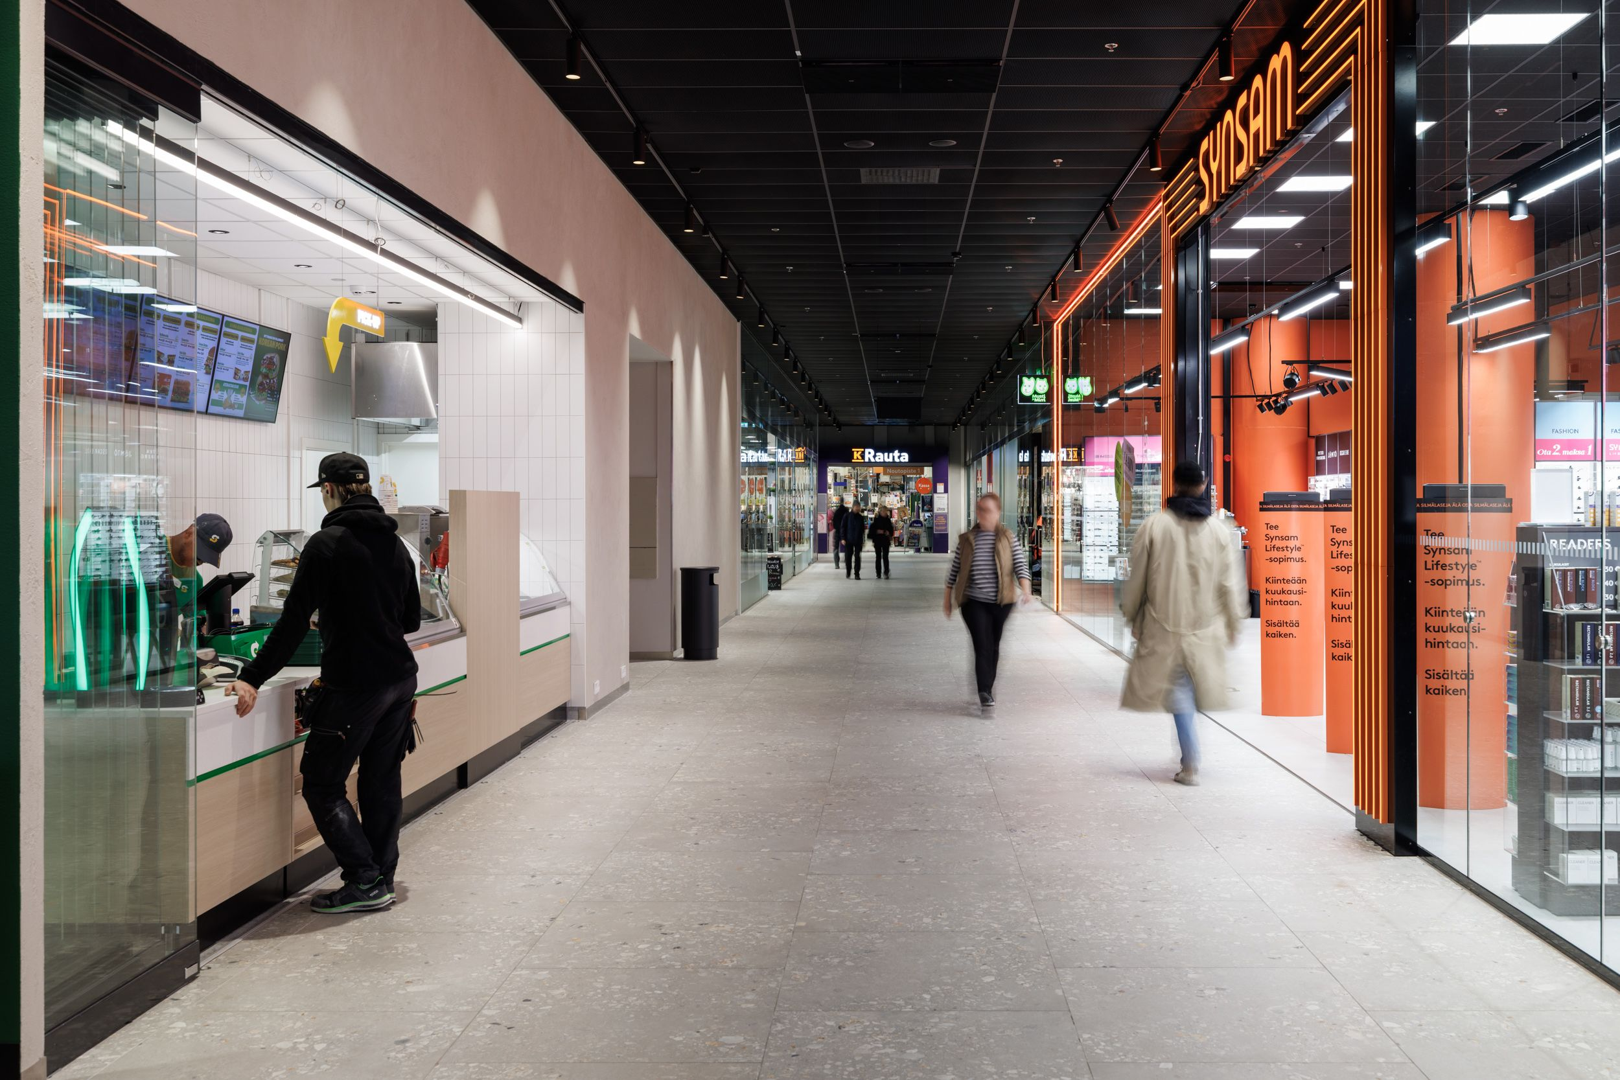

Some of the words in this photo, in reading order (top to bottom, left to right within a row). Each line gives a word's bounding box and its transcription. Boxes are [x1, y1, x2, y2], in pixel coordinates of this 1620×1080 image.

[1552, 444, 1561, 455] 2
[1587, 444, 1592, 455] 1
[1265, 522, 1279, 530] Tee
[1330, 525, 1347, 533] Tee
[1265, 533, 1298, 543] Synsam
[1423, 529, 1445, 540] Tee
[1550, 539, 1611, 550] READERS
[1265, 555, 1307, 565] -sopimus.
[1265, 576, 1307, 584] Kiinteään
[1265, 587, 1307, 595] kuukausi-
[1265, 598, 1302, 606] hintaan.
[1265, 619, 1299, 627] Sisältää
[1265, 630, 1296, 638] kaiken.
